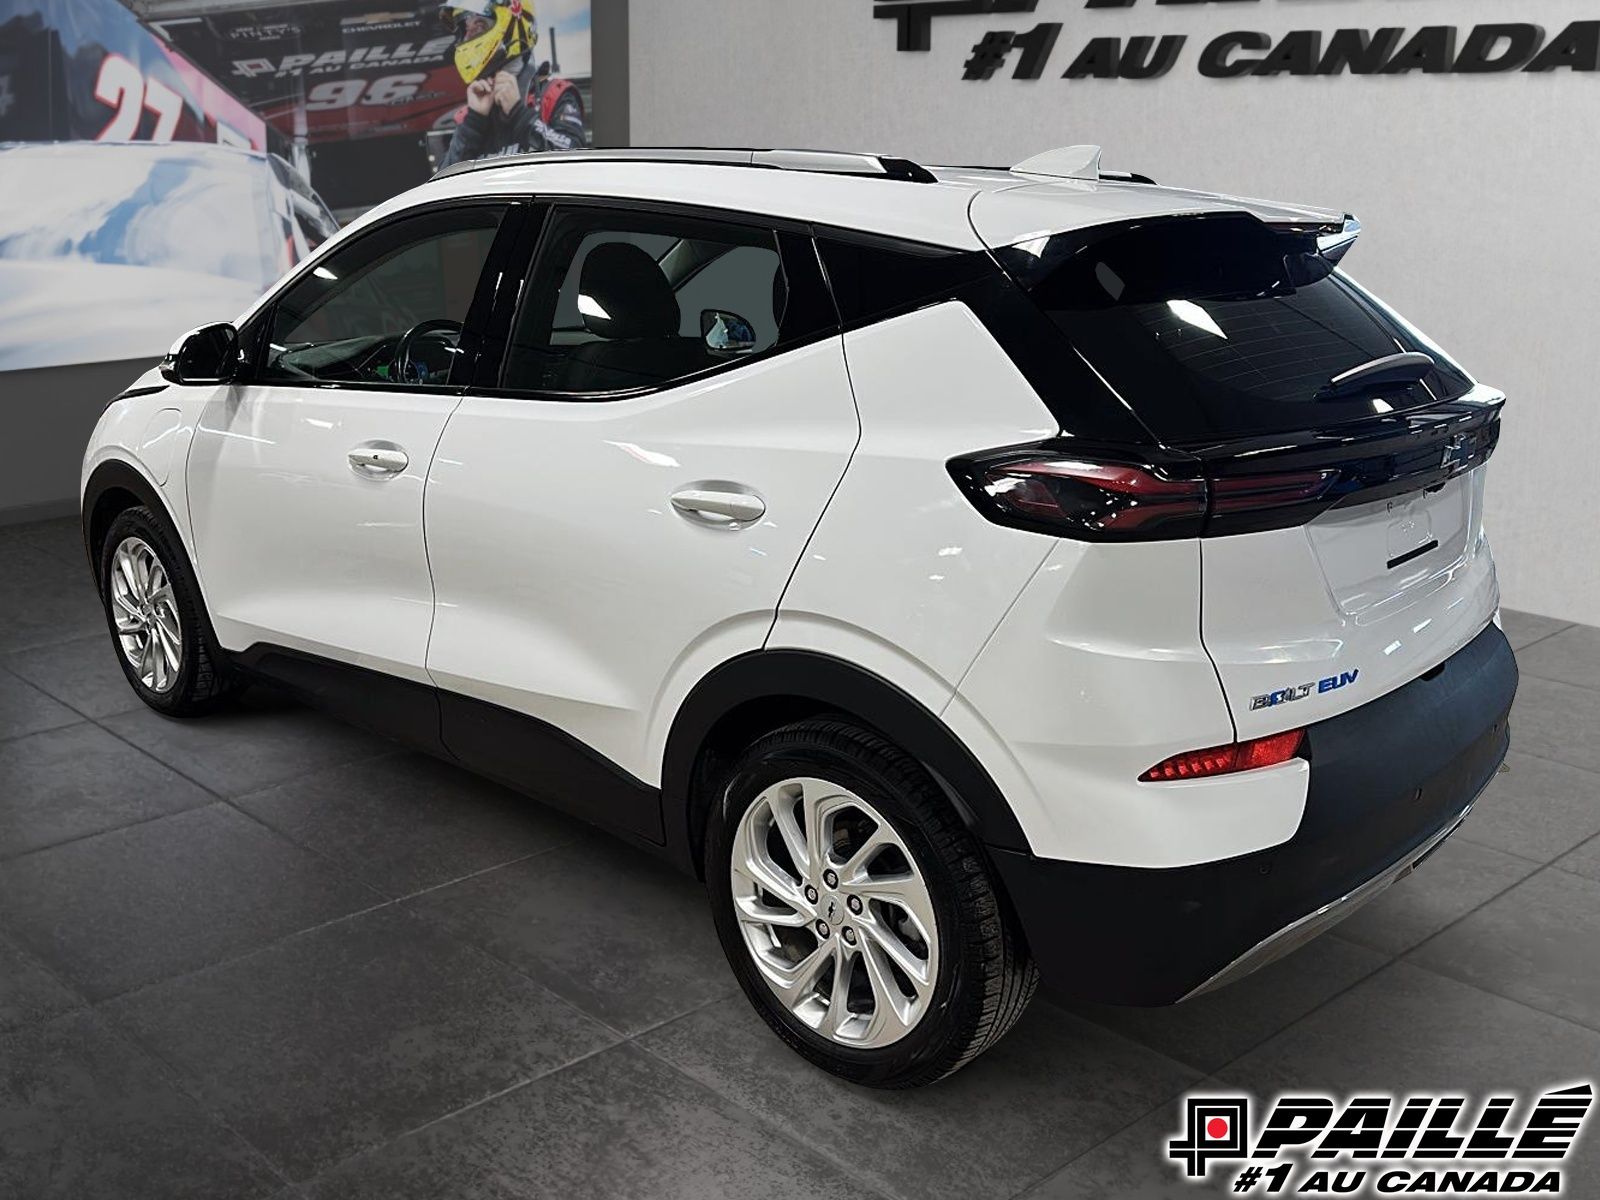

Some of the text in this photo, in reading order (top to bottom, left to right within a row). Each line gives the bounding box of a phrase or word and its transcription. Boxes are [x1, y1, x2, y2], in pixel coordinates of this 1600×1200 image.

[342, 21, 421, 33] CHEVROLET
[309, 64, 342, 74] AU
[349, 55, 445, 70] CANADA
[961, 20, 1600, 80] #1 AU CANADA
[95, 53, 183, 142] 27
[305, 73, 428, 111] 96
[1250, 668, 1360, 711] BOLT EUV
